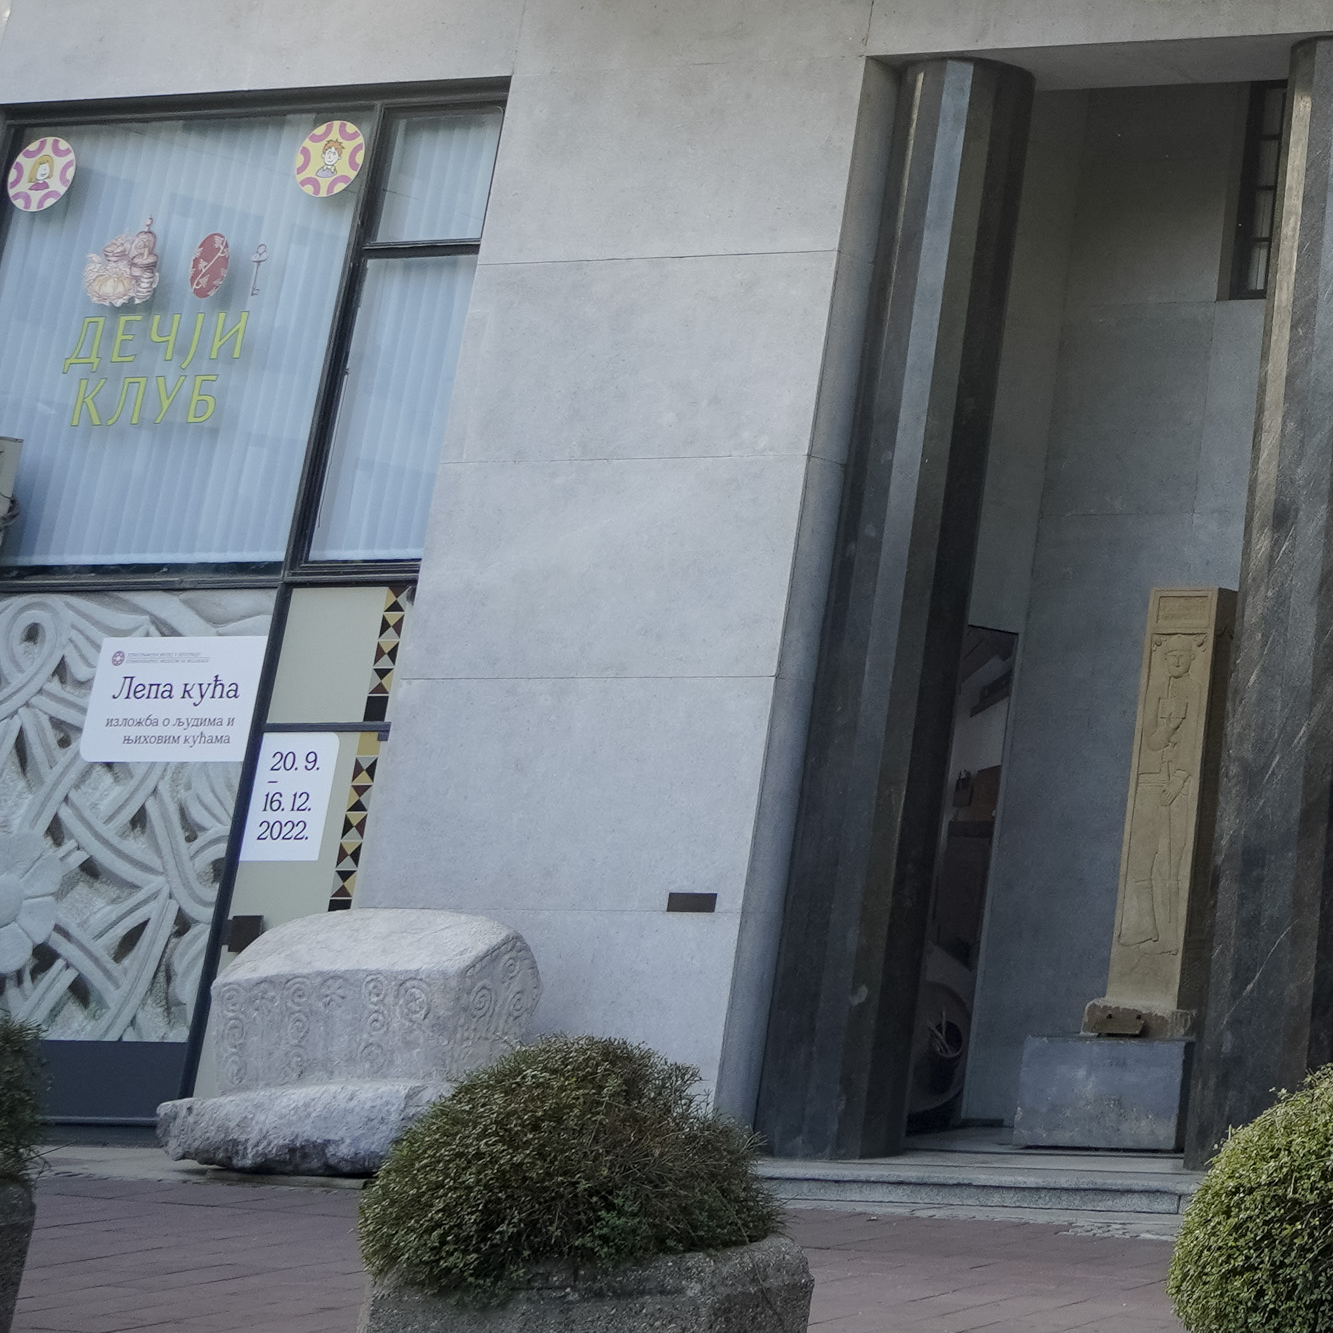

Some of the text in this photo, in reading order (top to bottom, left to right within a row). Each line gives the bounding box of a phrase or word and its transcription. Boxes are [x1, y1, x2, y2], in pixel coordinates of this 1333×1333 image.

[62, 311, 249, 374] ДЕЧЈИ
[70, 374, 219, 427] КЛУБ
[112, 674, 240, 707] Лепа кућа
[105, 714, 236, 730] изложба о људима и
[122, 731, 231, 748] њиховим кућама
[269, 751, 320, 771] 20. 9.
[262, 791, 312, 812] 16. 12.
[256, 820, 309, 841] 2022.
